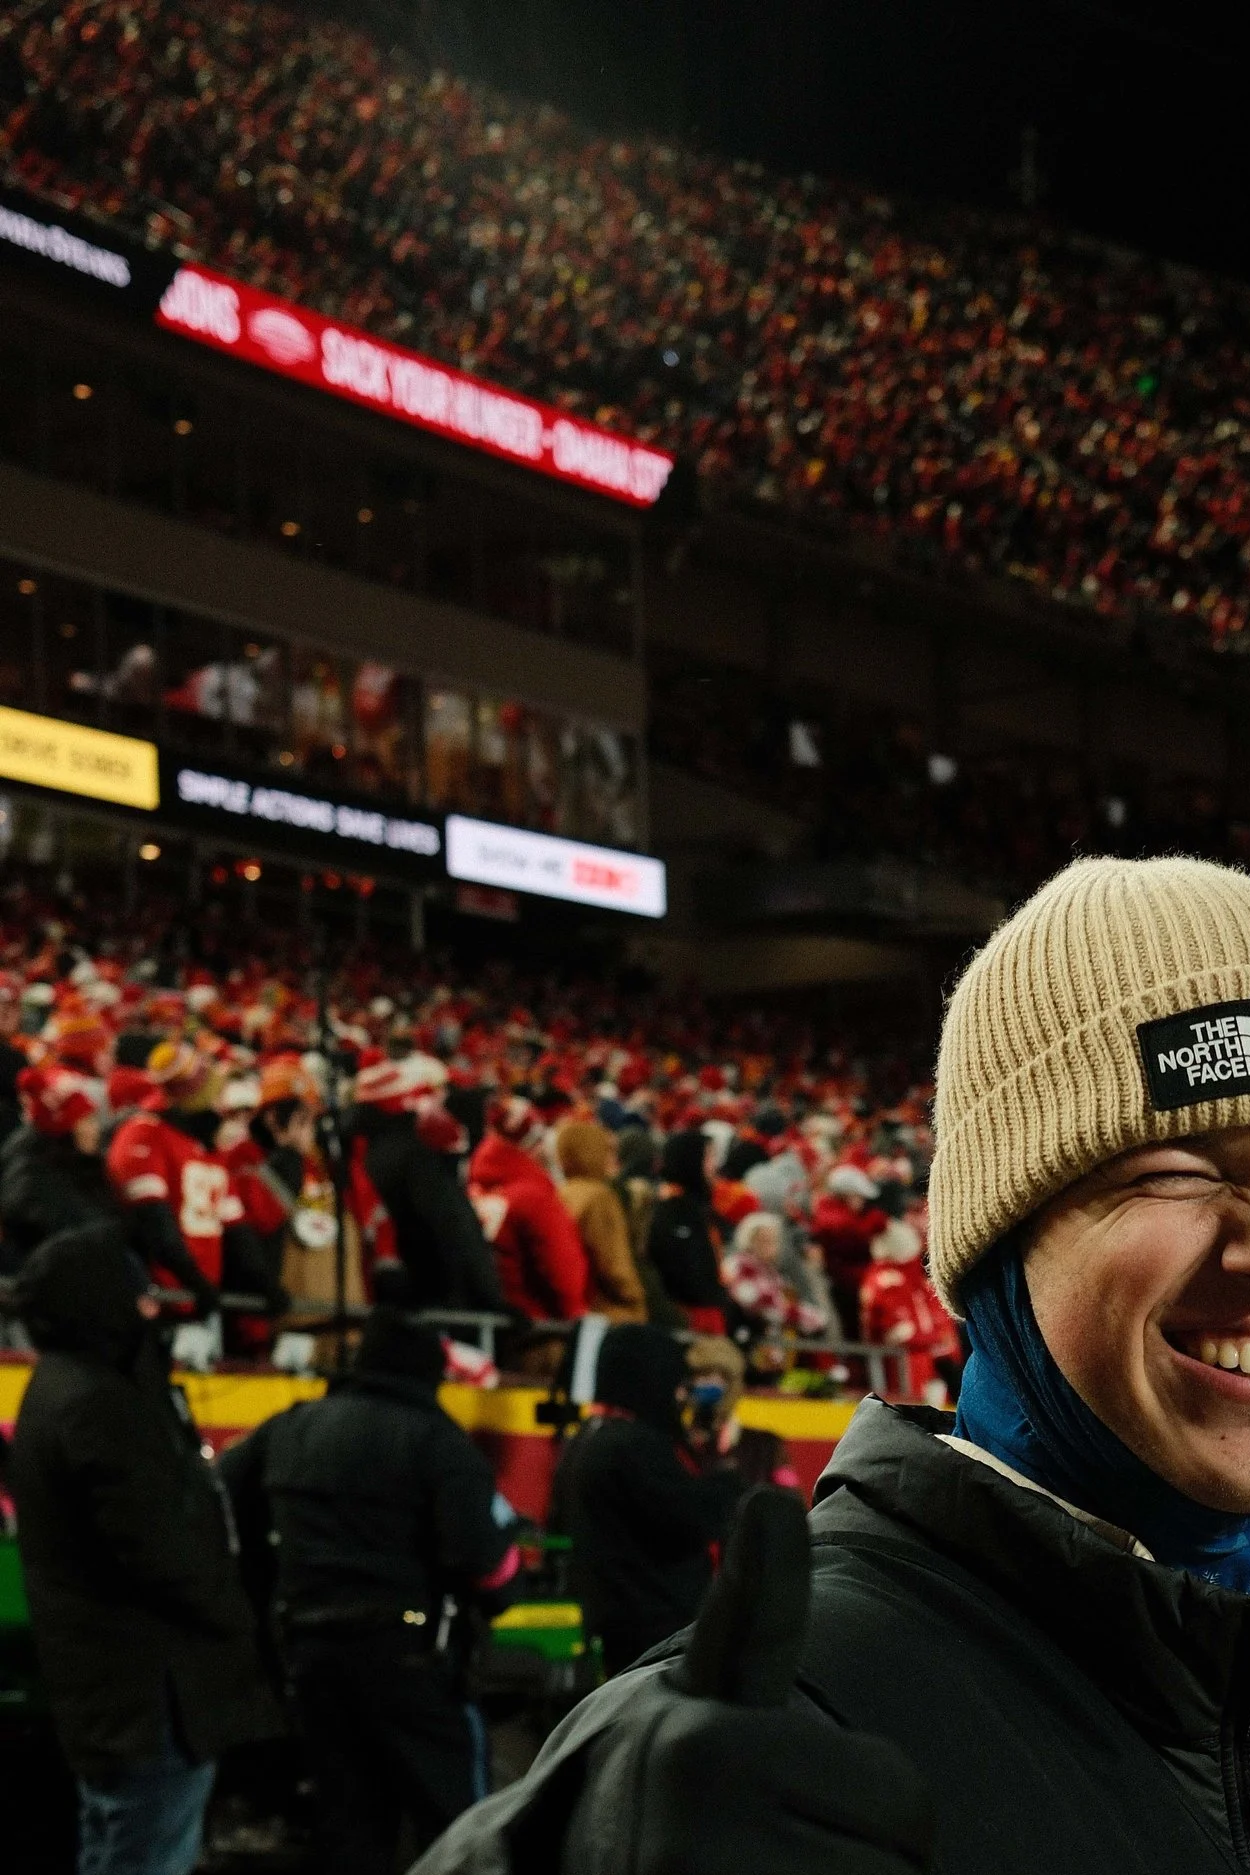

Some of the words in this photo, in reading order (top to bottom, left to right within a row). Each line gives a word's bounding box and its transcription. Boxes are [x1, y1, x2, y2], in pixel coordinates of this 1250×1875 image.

[1190, 1016, 1239, 1043] THE
[1157, 1036, 1243, 1074] NORTH
[1186, 1056, 1248, 1087] FACE
